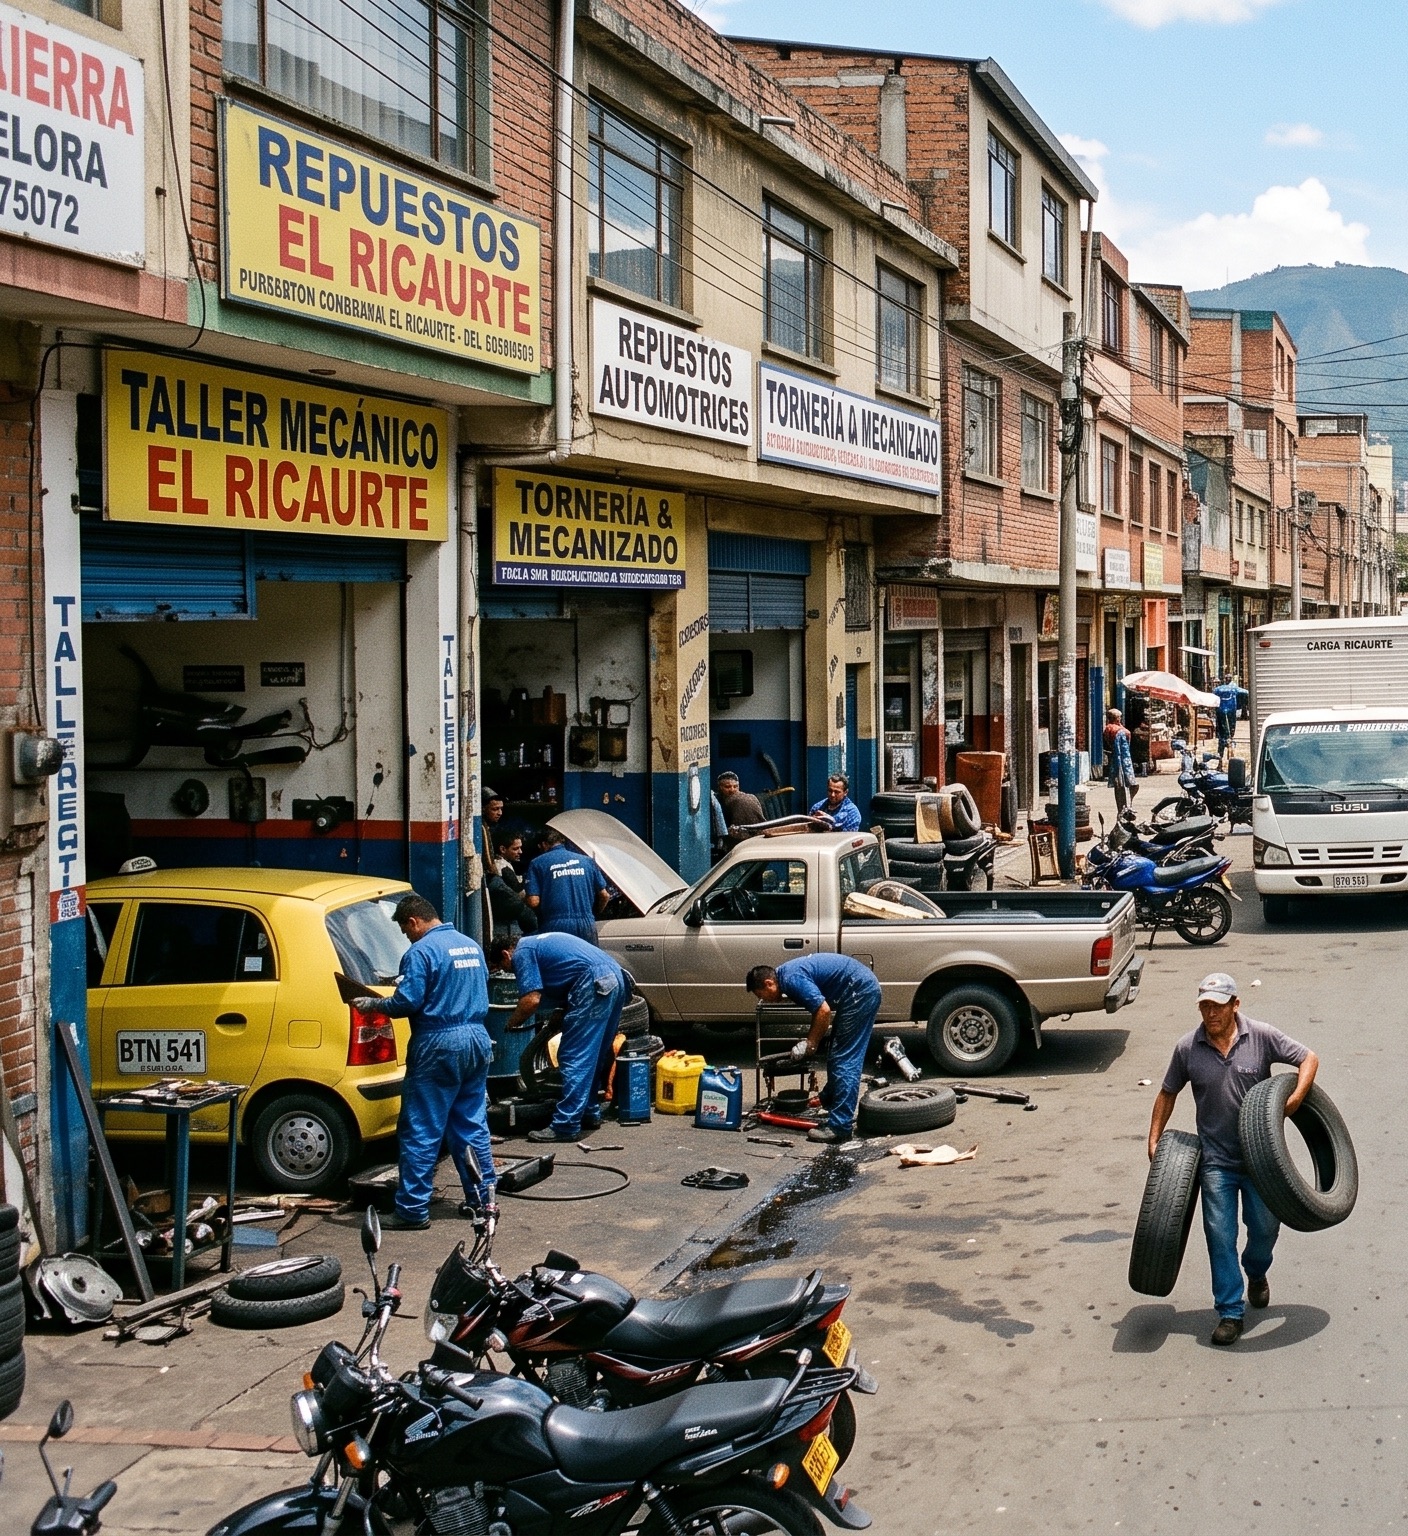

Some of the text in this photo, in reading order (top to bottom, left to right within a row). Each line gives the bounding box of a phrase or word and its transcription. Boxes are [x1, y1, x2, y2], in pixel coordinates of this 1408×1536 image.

[0, 20, 134, 136] IERRA
[258, 126, 520, 272] REPUESTOS
[279, 204, 532, 336] EL RICAURTE
[390, 308, 402, 330] EL
[406, 312, 455, 344] RICAURTE
[464, 328, 482, 350] DEL
[619, 317, 732, 388] REPUESTOS
[121, 368, 438, 470] TALLER MECÁNICO
[599, 364, 750, 437] AUTOMOTRICES
[766, 379, 844, 443] TORNERÍA
[862, 408, 938, 466] MECANIZADO
[148, 444, 429, 532] EL RICAURTE
[515, 479, 673, 529] TORNERÍA &
[510, 521, 678, 565] MECANIZADO
[1307, 640, 1393, 650] CARGA RICAURTE
[120, 1039, 201, 1062] BTN 541
